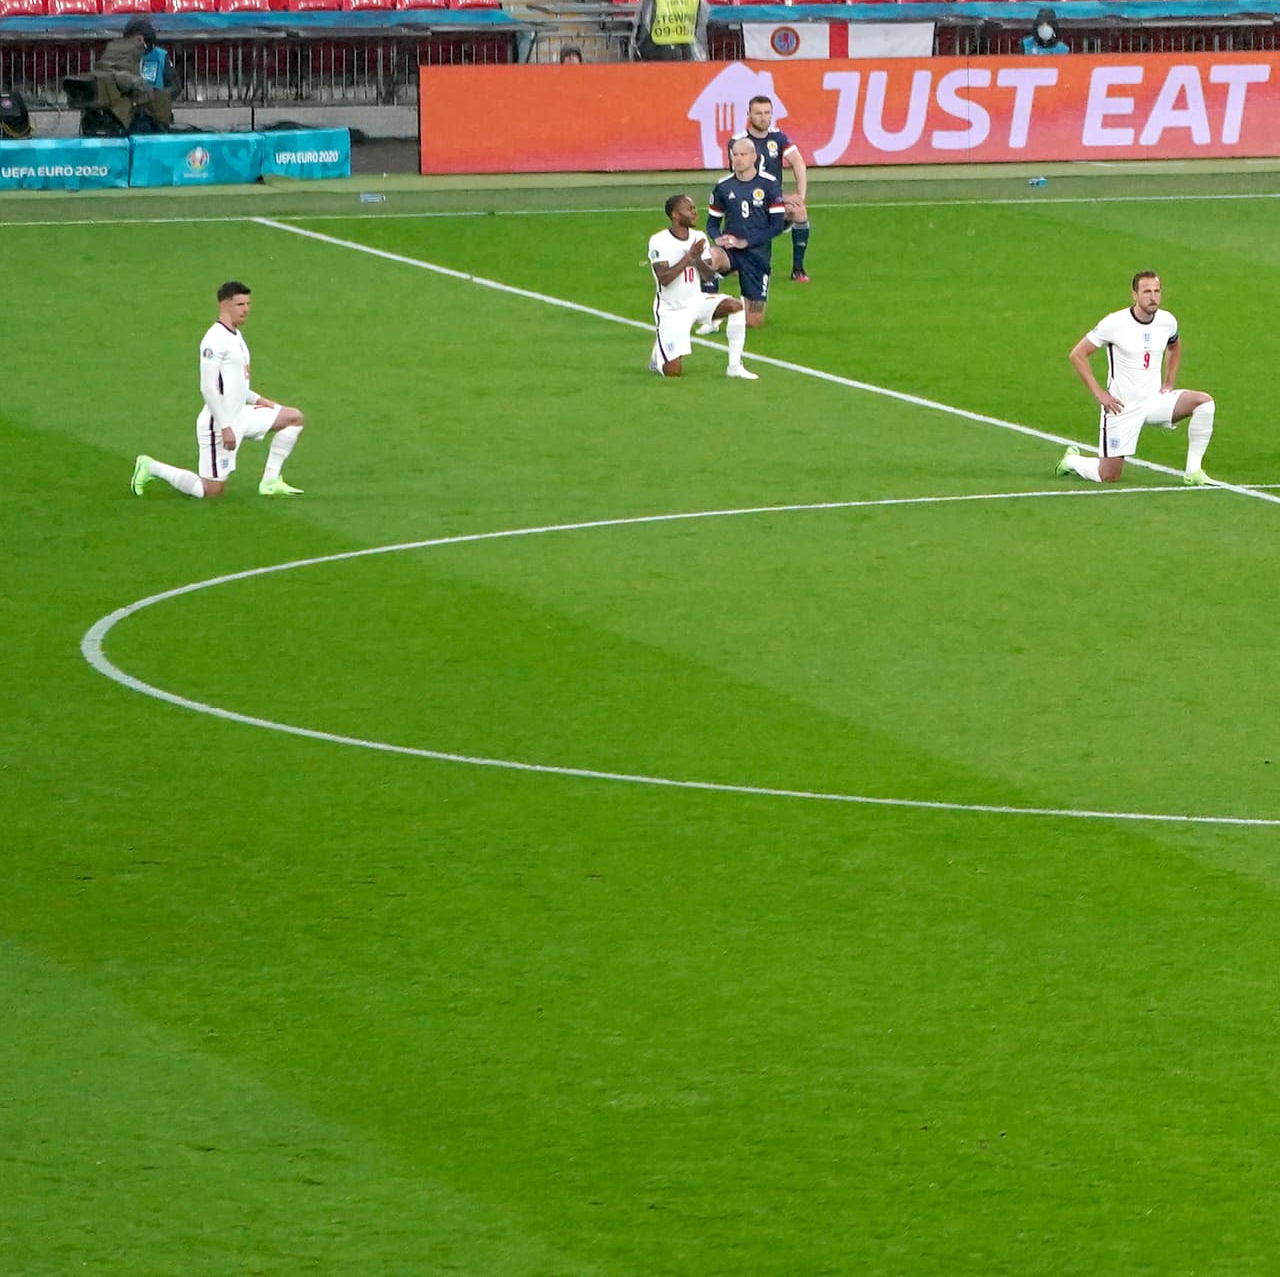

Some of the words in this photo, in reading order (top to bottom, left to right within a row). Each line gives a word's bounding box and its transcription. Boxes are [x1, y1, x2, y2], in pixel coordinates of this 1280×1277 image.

[812, 67, 1060, 166] JUST
[1081, 63, 1272, 146] EAT
[275, 151, 297, 164] UEFA
[296, 149, 319, 164] EURO
[319, 149, 339, 163] 2020
[1, 166, 36, 179] UEFA
[37, 164, 74, 177] EURO
[74, 165, 109, 177] 2020
[741, 199, 750, 219] 9
[683, 266, 695, 284] 10
[1143, 350, 1151, 369] 9
